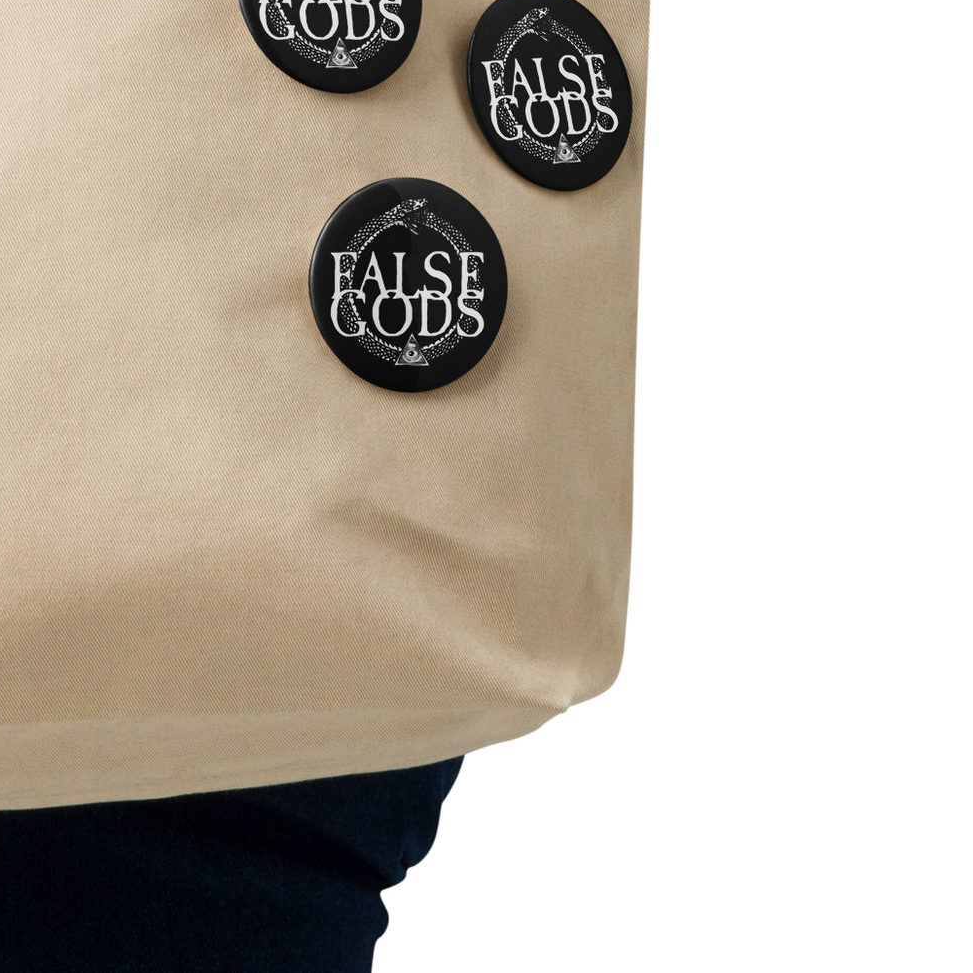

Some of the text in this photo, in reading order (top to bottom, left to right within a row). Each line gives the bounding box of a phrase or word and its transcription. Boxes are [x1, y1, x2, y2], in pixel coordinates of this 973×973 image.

[481, 54, 613, 107] FALSE
[490, 88, 619, 141] GODS
[330, 251, 485, 301] FALSE
[330, 289, 485, 338] GODS
